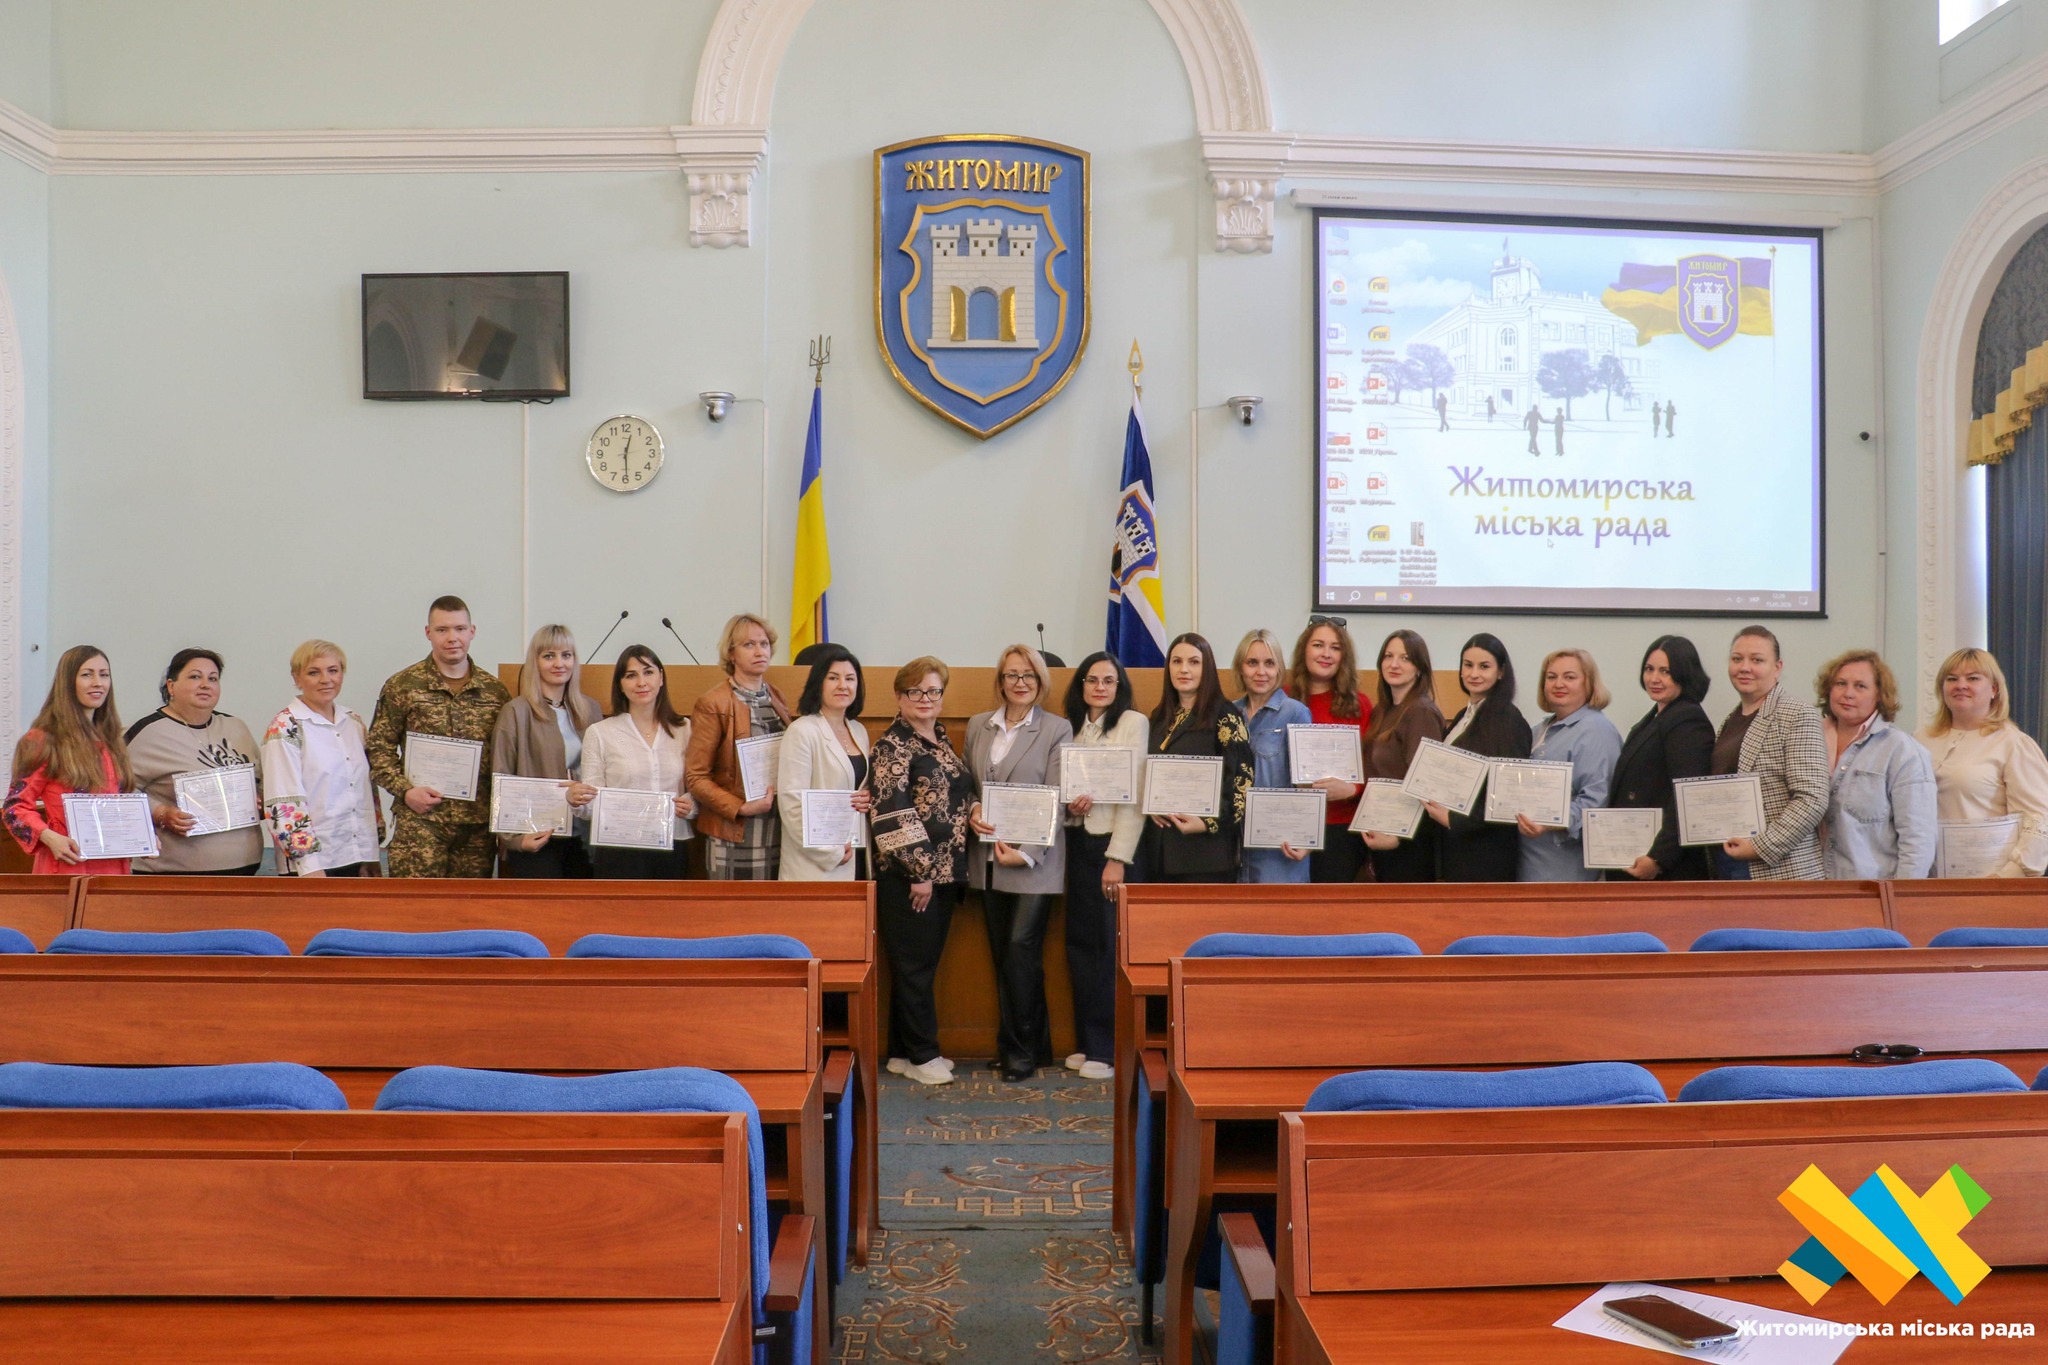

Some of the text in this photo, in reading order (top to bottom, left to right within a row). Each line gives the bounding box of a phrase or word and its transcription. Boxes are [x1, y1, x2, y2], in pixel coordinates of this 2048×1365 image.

[904, 158, 1062, 193] ЖИТОМИР
[610, 427, 618, 436] 11
[621, 423, 631, 433] 12
[637, 427, 641, 436] 1
[599, 437, 610, 447] 10
[645, 436, 653, 446] 2
[596, 449, 604, 459] 9
[648, 449, 656, 459] 3
[600, 462, 607, 471] 8
[644, 462, 651, 470] 4
[610, 472, 618, 481] 7
[622, 474, 629, 484] 6
[635, 471, 642, 481] 5
[1447, 466, 1695, 511] Житомирська
[1474, 506, 1671, 548] міська рада
